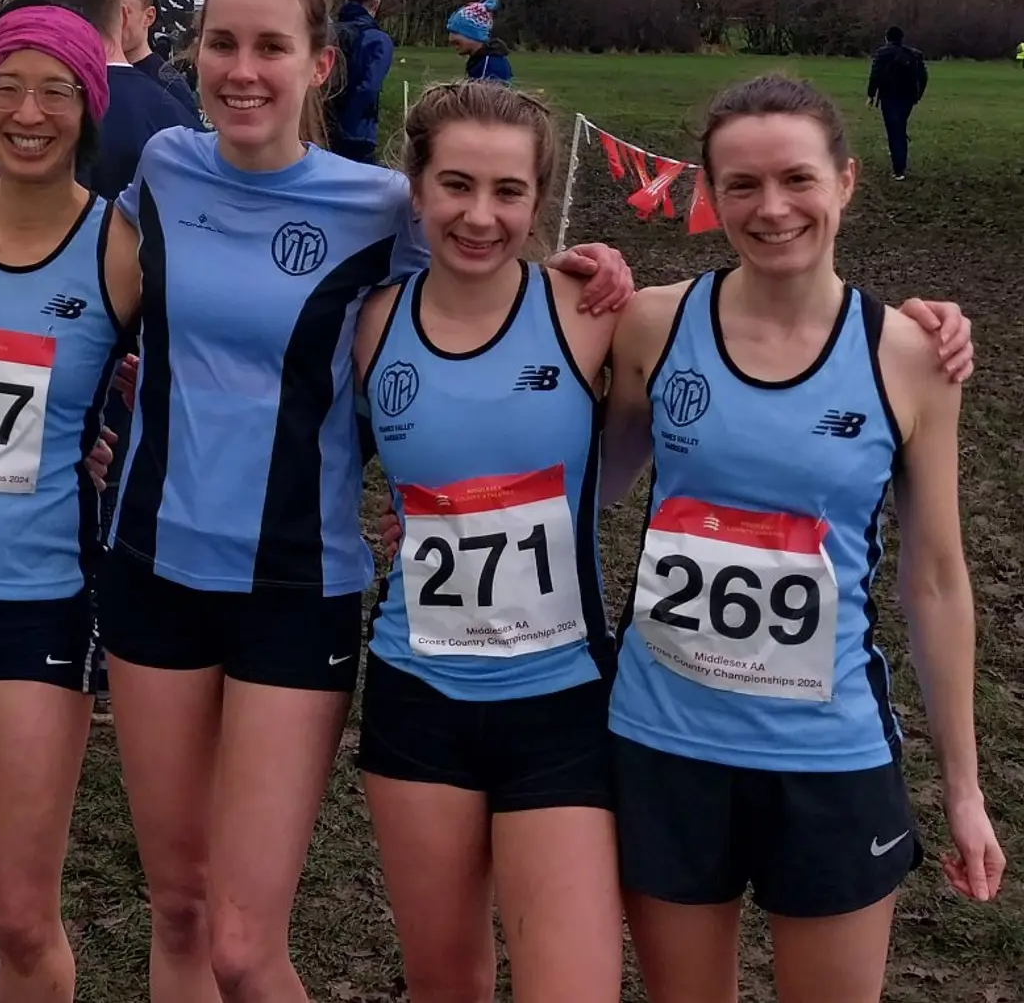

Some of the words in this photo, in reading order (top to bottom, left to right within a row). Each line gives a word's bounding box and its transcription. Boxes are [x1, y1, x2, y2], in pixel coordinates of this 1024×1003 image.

[9, 475, 29, 483] 2024
[414, 524, 554, 607] 271
[649, 554, 820, 645] 269
[418, 637, 446, 645] Cross
[448, 636, 485, 647] Country
[487, 629, 556, 646] Championships
[557, 620, 576, 633] 2024
[465, 625, 513, 635] Middlesex
[515, 620, 529, 629] AA
[646, 642, 672, 659] Cross
[674, 654, 711, 675] Country
[713, 668, 795, 686] Championships
[797, 678, 823, 688] 2024
[695, 651, 747, 669] Middlesex
[750, 663, 765, 672] AA
